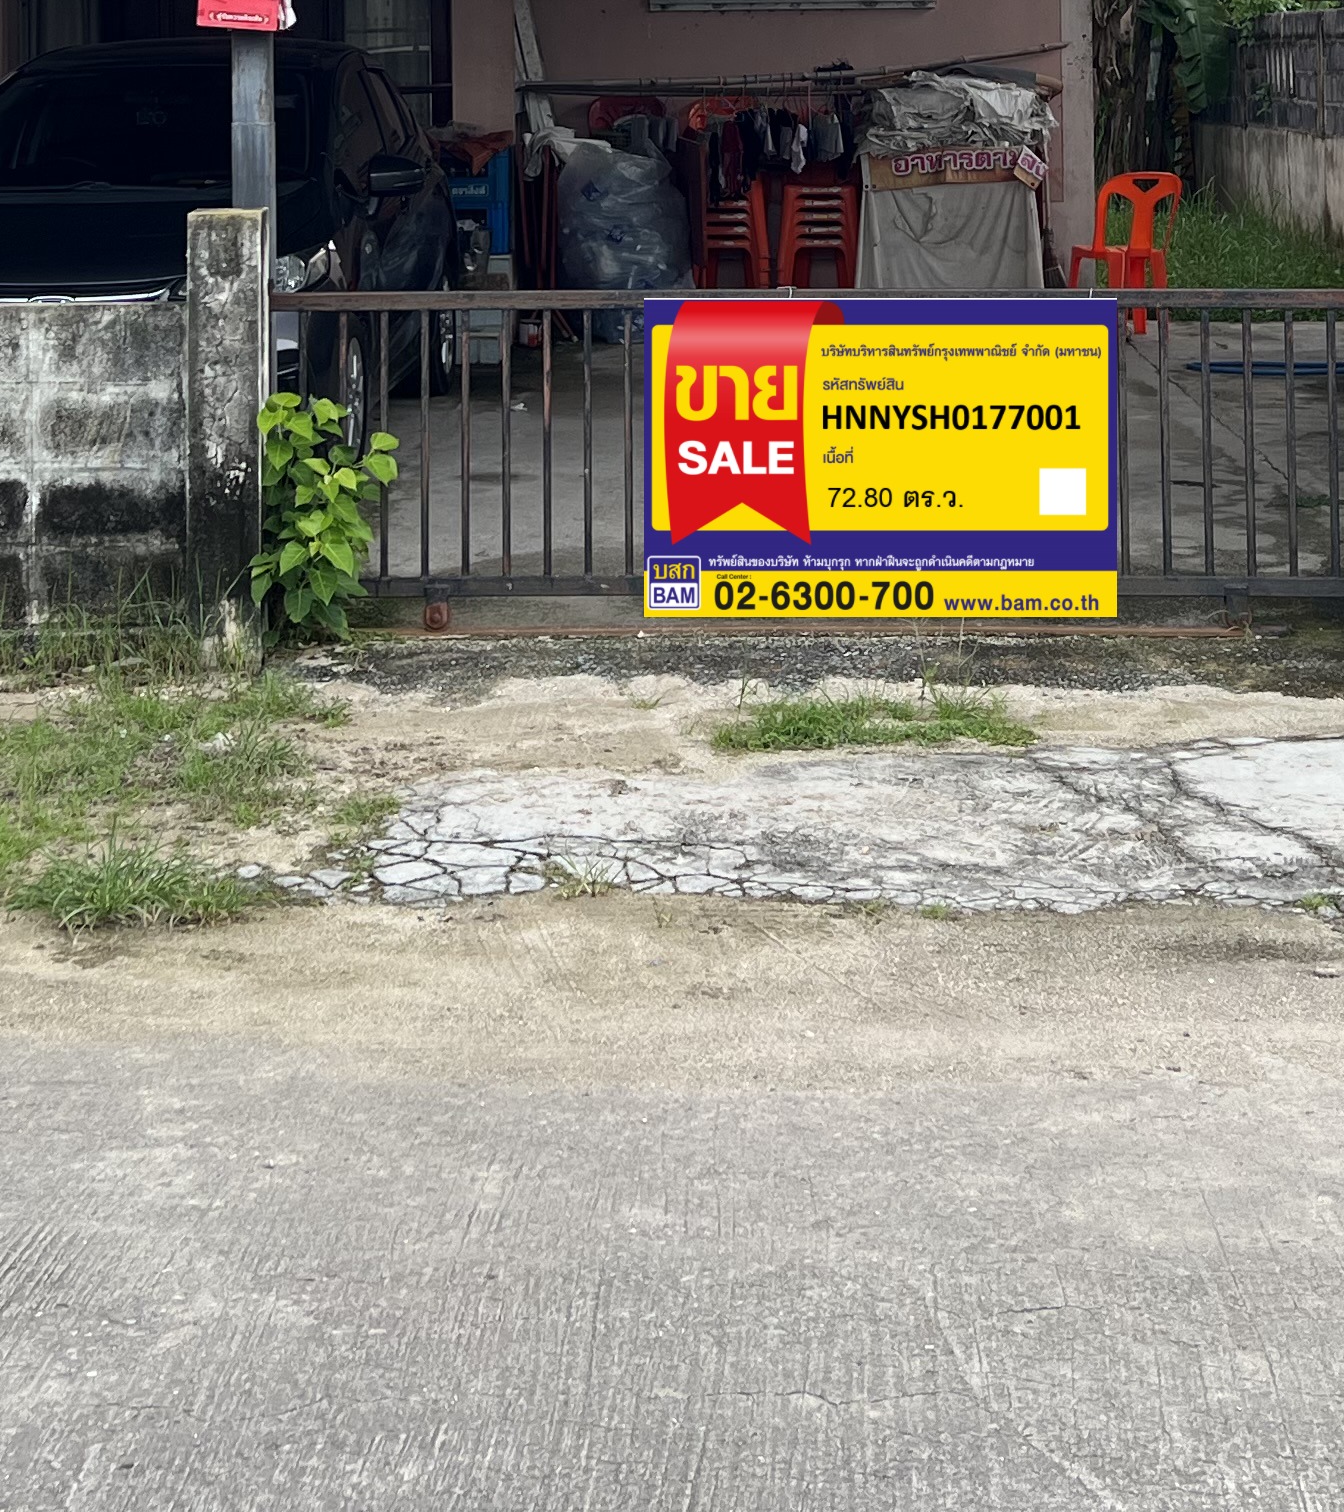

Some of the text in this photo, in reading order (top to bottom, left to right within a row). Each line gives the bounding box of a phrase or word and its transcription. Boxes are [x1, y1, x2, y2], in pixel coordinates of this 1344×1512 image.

[821, 343, 1102, 361] บริษัทบริหารสินทรัพย์กรุงเทพพาณิชย์ จำกัด (มหาชน)
[676, 365, 798, 421] ขาย
[822, 377, 904, 391] รหัสทรัพย์สิน
[822, 404, 1081, 431] HNNYSH0177001
[678, 441, 795, 475] SALE
[823, 445, 854, 464] เนื้อที่
[828, 487, 963, 508] 72.80 ตร.ว.
[653, 562, 695, 580] บสก
[708, 554, 799, 567] ทรัพย์สินของบริษัท
[803, 554, 851, 571] ห้ามบุกรุก
[653, 587, 695, 604] BAM
[714, 581, 1099, 611] 02-6300-700 www.bam.co.th
